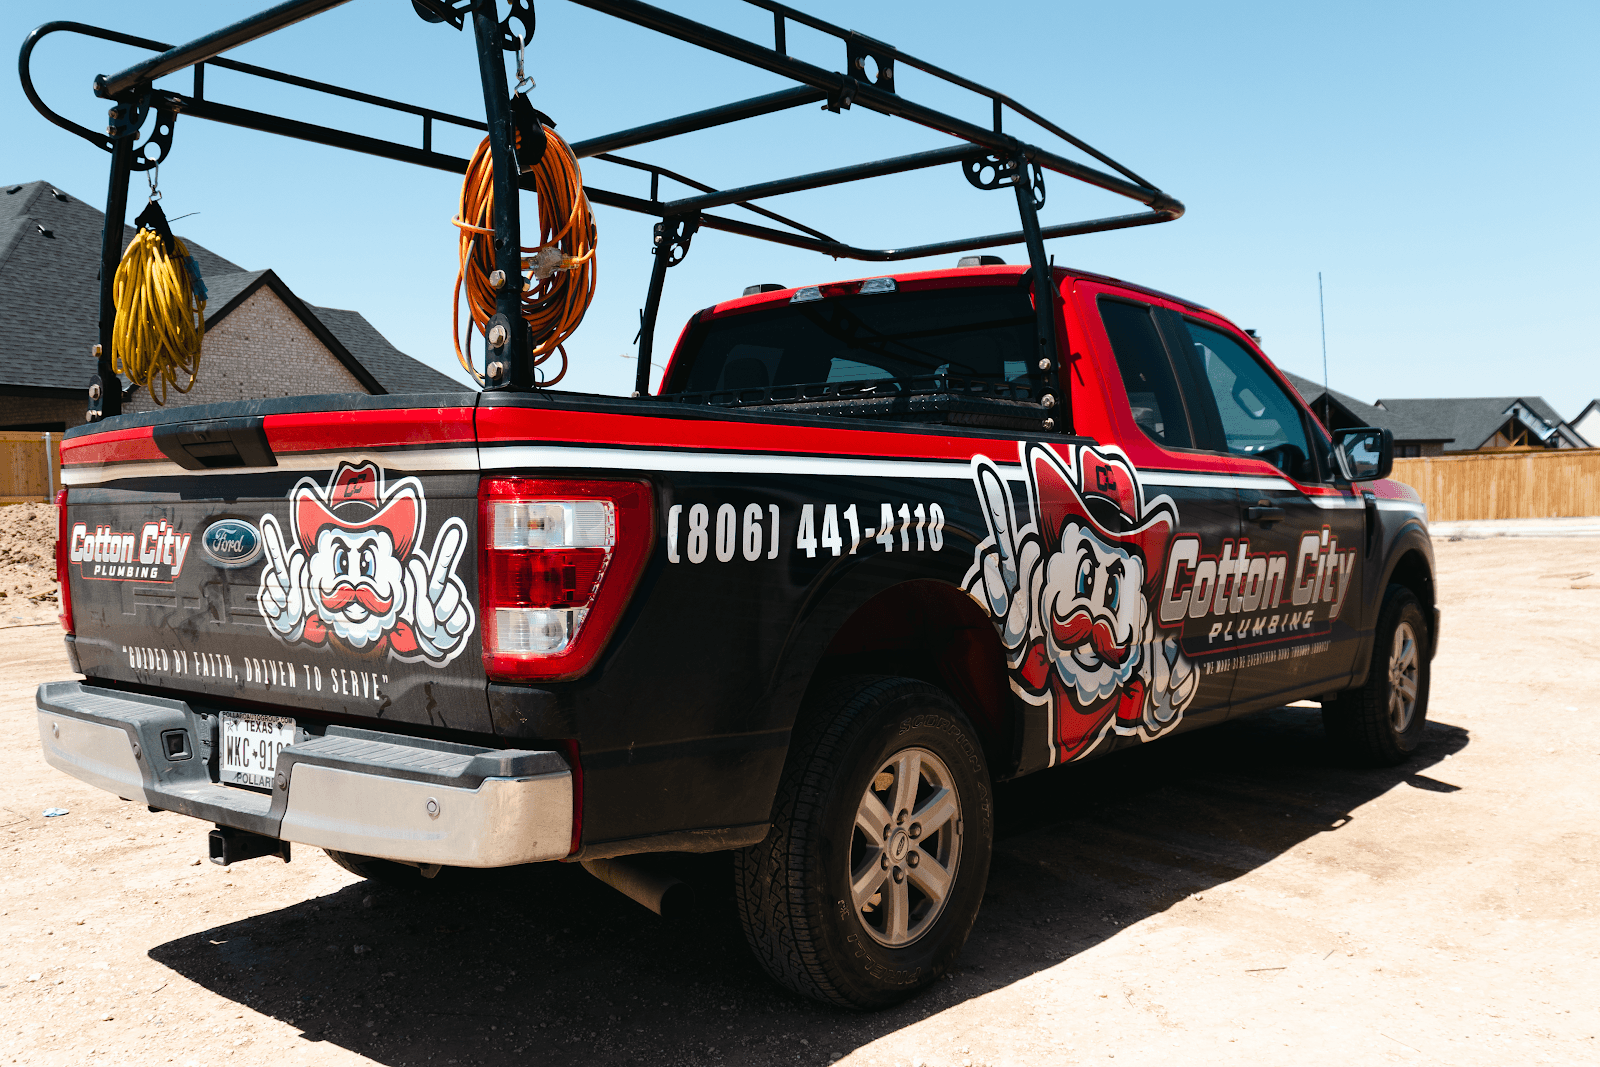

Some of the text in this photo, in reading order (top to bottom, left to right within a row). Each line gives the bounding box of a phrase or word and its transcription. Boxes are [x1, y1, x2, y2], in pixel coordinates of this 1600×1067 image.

[69, 519, 192, 577] Cotton City
[212, 527, 245, 553] Ford
[667, 503, 780, 564] (806)
[93, 564, 159, 580] PLUMBING
[1159, 528, 1356, 622] Cotton City
[1208, 609, 1315, 644] PLUMBING
[122, 645, 389, 701] "GUIDED BY FAITH, DRIVEN TO SERVE"
[244, 720, 273, 734] TEXAS
[226, 735, 250, 767] WKC
[846, 933, 922, 985] PIRELLI
